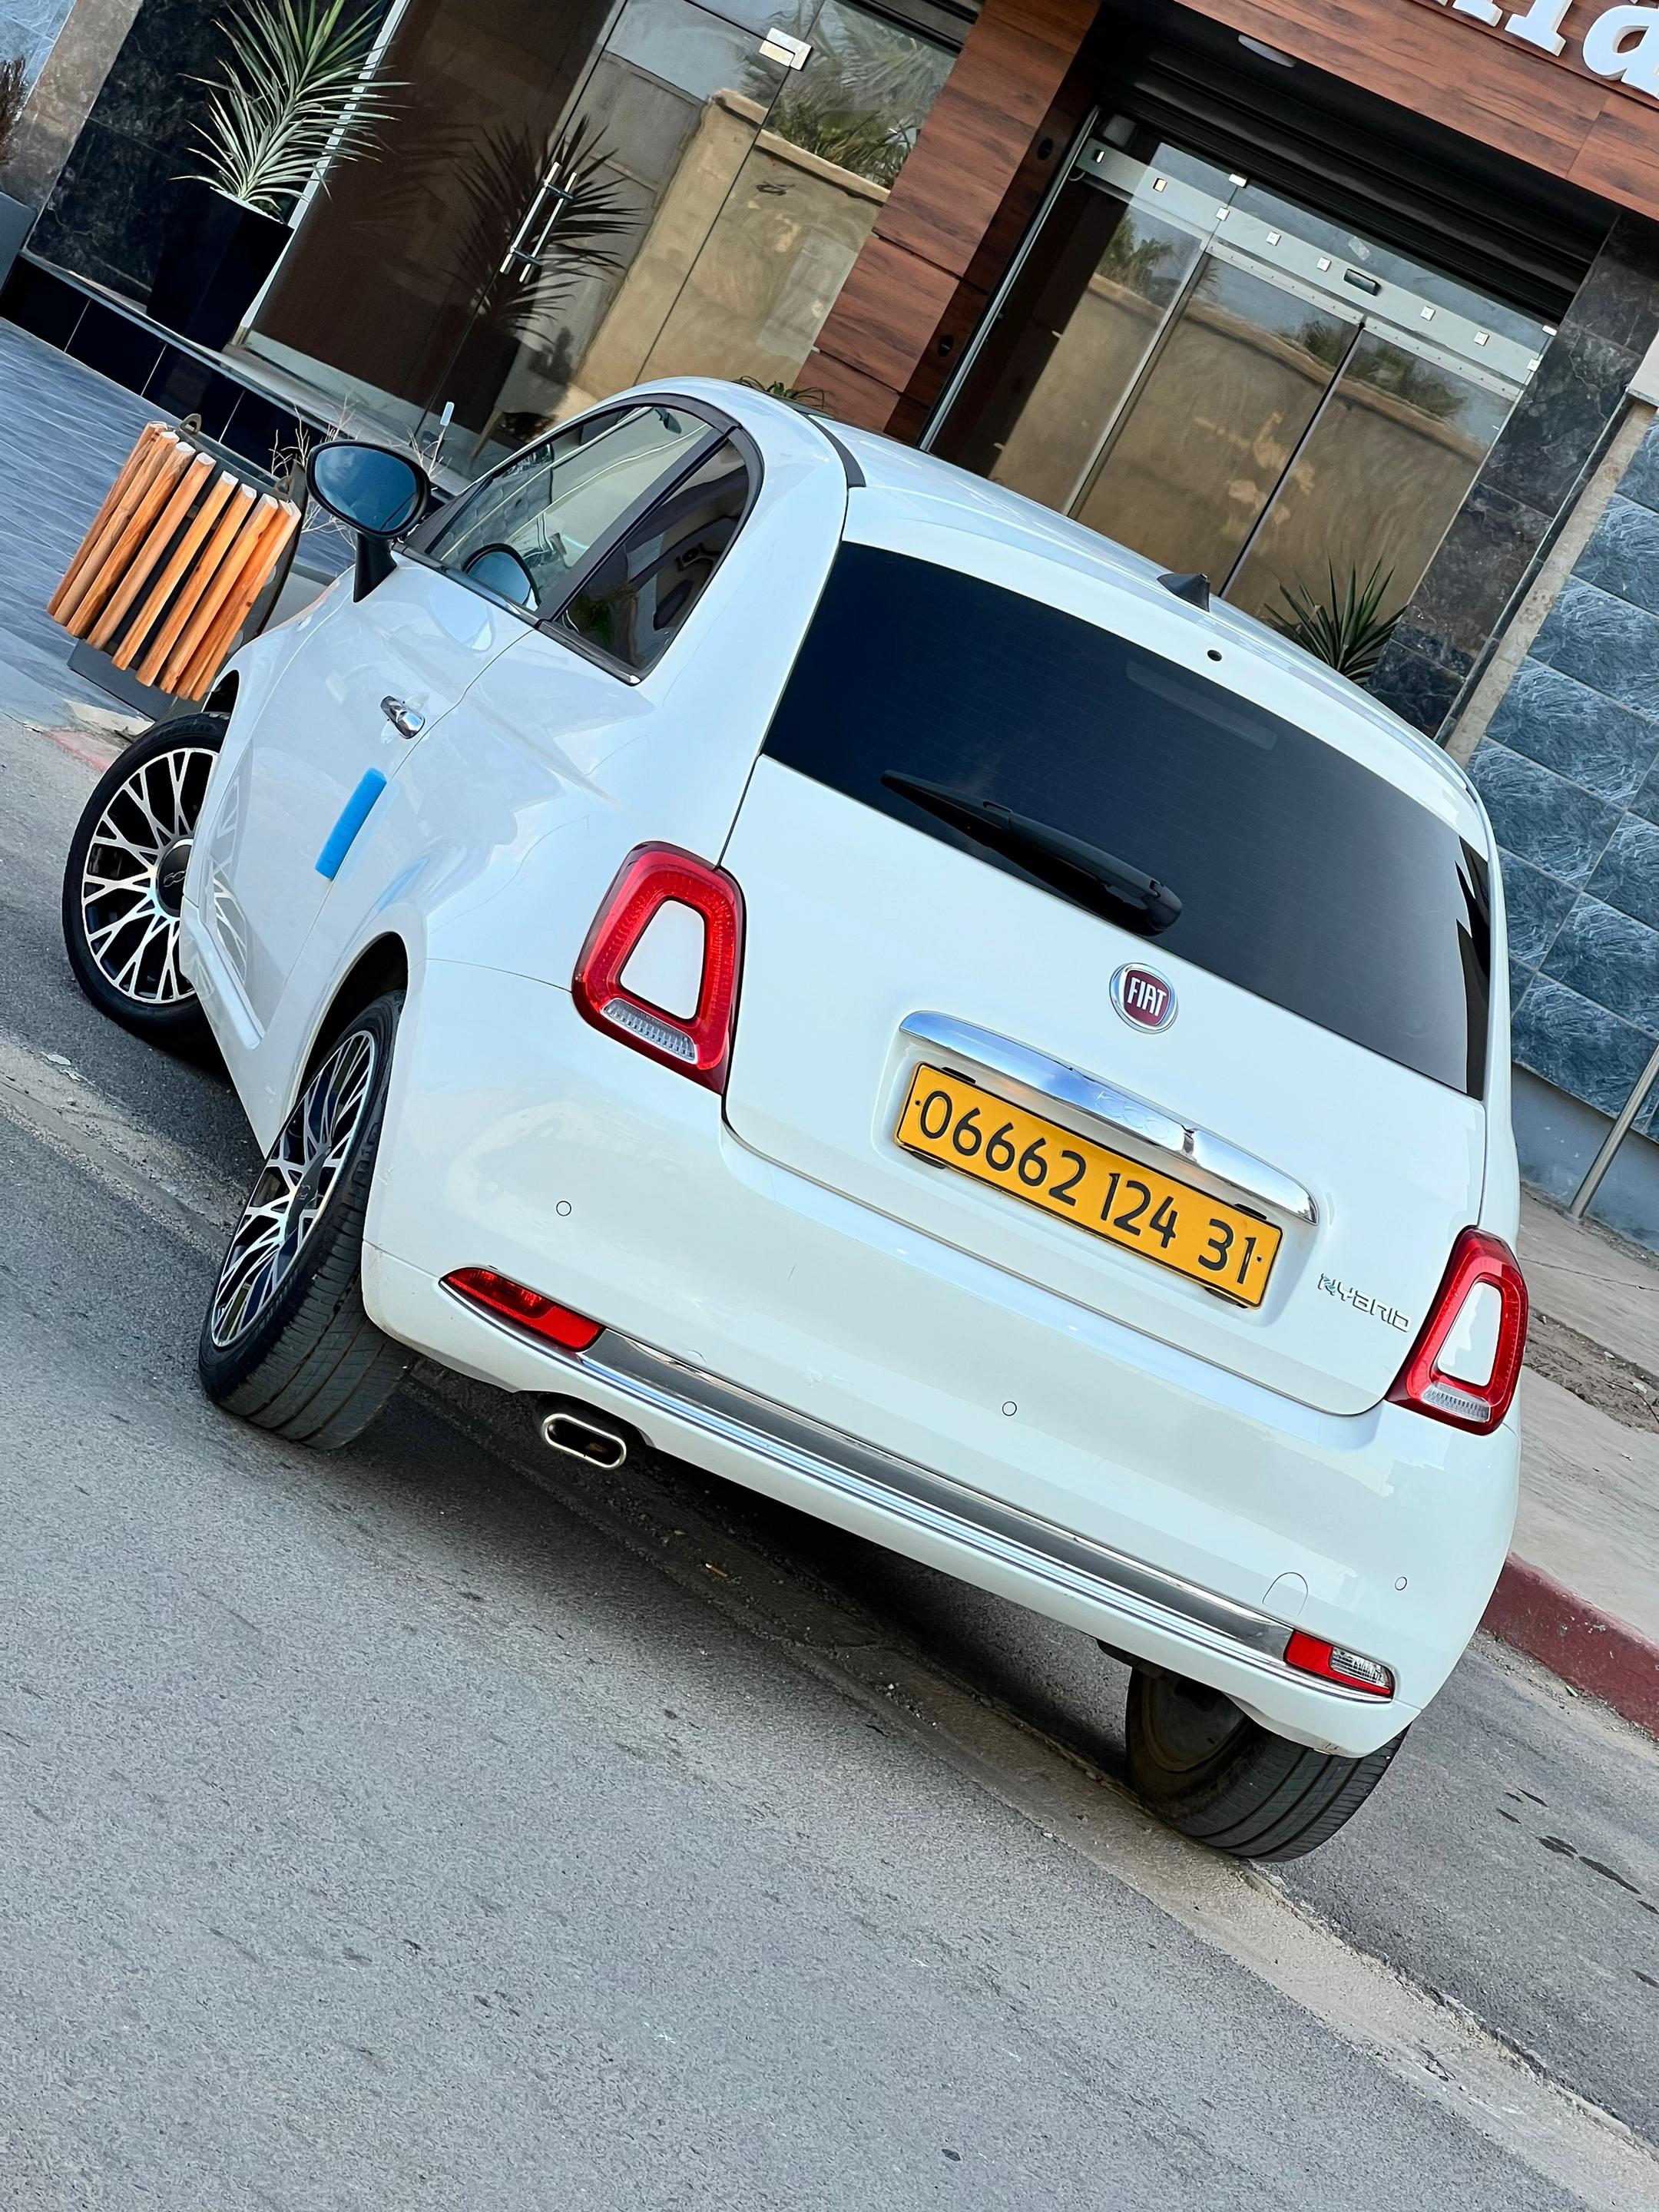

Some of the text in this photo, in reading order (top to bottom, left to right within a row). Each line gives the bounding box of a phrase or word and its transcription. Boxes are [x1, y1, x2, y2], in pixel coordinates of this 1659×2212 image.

[1127, 976, 1167, 1017] FIAT
[919, 1090, 1257, 1285] 06662 124 31
[1317, 1273, 1412, 1333] HYBRID
